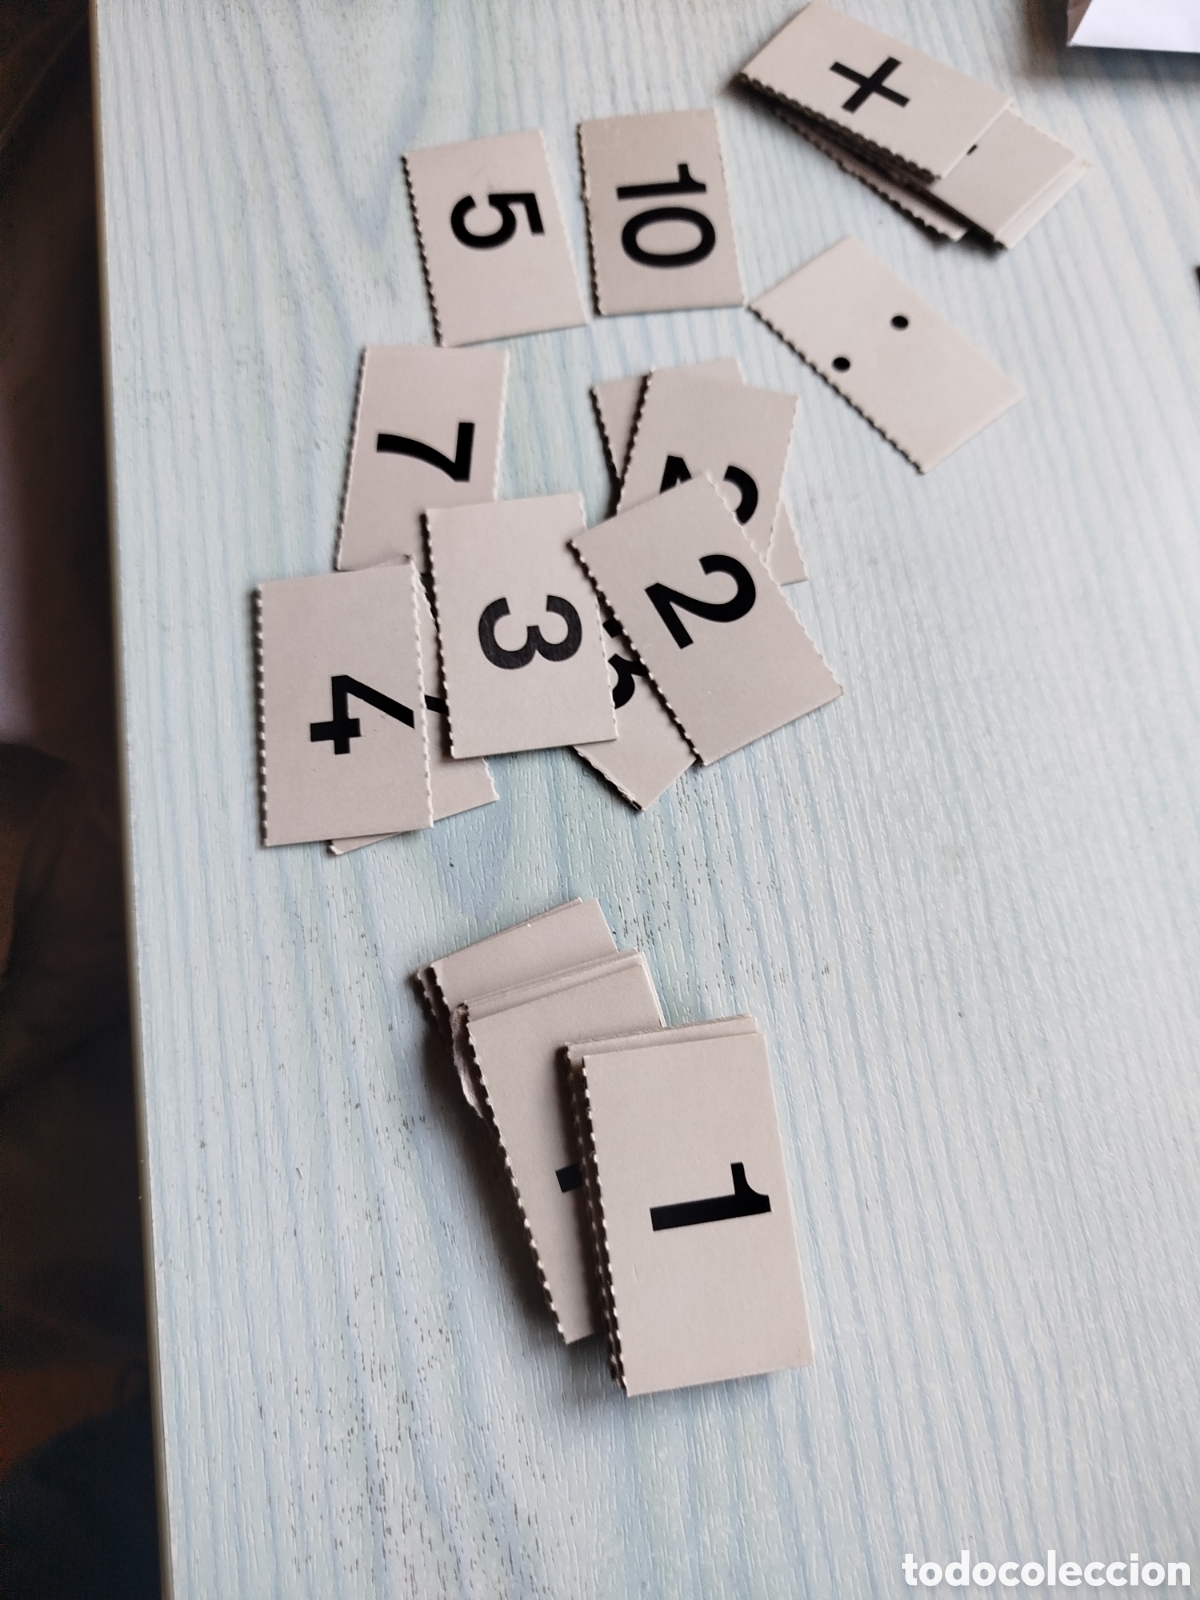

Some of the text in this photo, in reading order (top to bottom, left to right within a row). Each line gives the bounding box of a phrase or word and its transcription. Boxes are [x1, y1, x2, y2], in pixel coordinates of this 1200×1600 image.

[449, 191, 546, 250] 5
[617, 162, 717, 269] 10
[376, 421, 475, 483] 7
[478, 594, 582, 671] 3
[645, 553, 757, 650] 2
[309, 675, 415, 755] 4
[649, 1162, 772, 1232] 1
